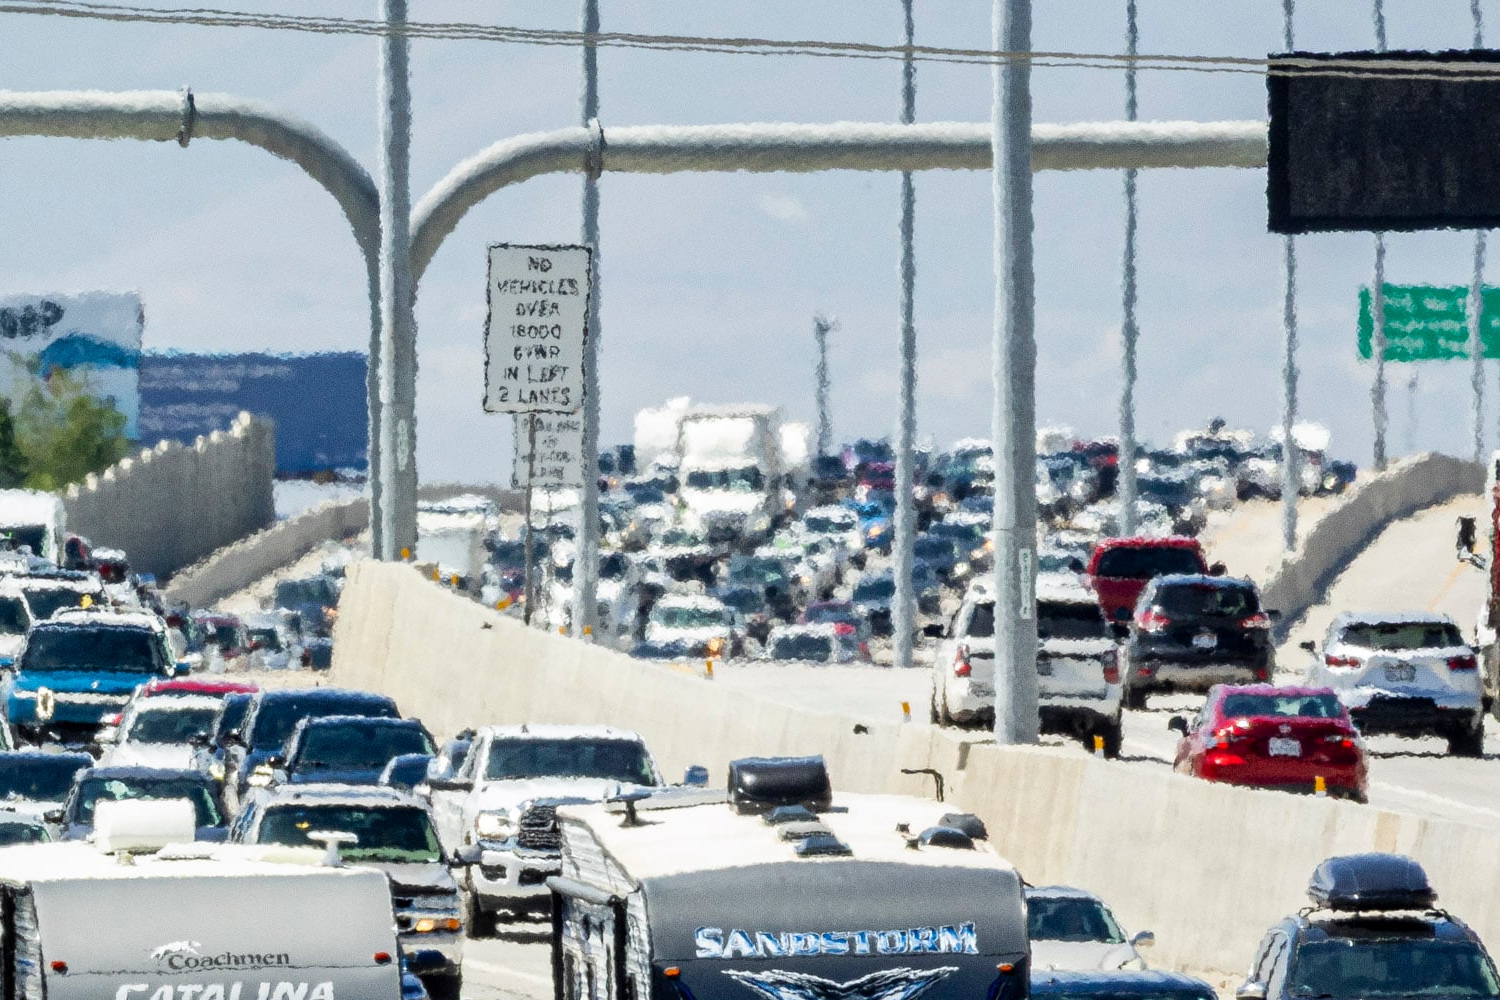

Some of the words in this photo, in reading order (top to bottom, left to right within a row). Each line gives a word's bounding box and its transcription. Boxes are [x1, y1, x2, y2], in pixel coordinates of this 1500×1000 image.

[528, 256, 552, 272] NO
[497, 278, 580, 296] VEHICLES
[515, 301, 560, 317] OVER
[503, 366, 518, 382] IN
[527, 366, 569, 383] LEFT
[499, 386, 509, 403] 2
[518, 387, 572, 406] LANES
[694, 919, 980, 960] SANDSTORM
[167, 951, 291, 971] Coachmen
